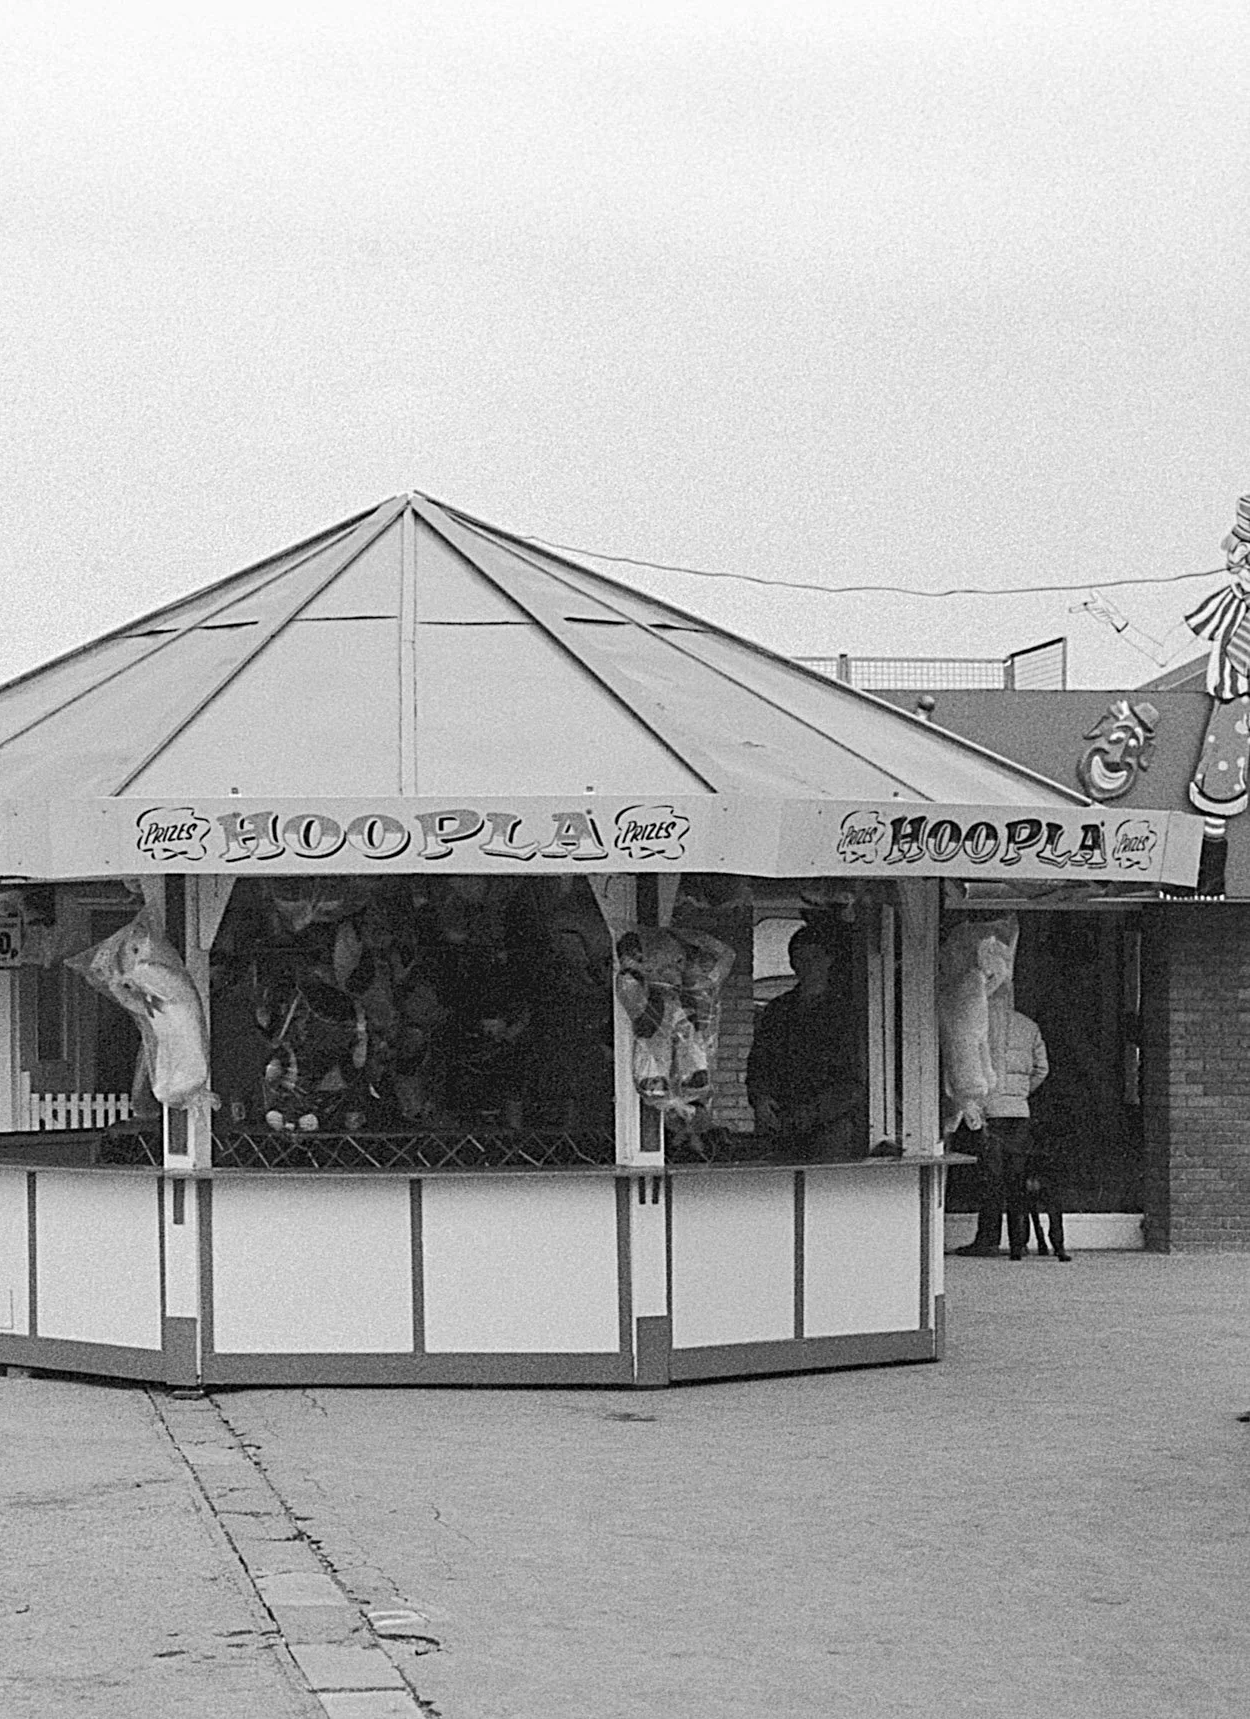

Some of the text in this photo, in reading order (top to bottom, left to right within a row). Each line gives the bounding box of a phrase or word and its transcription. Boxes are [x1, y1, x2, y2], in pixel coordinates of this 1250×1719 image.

[143, 809, 677, 862] PRIZES HOOPLA PRIZES
[842, 815, 1150, 869] PRIZES HOOPLA PRIZES
